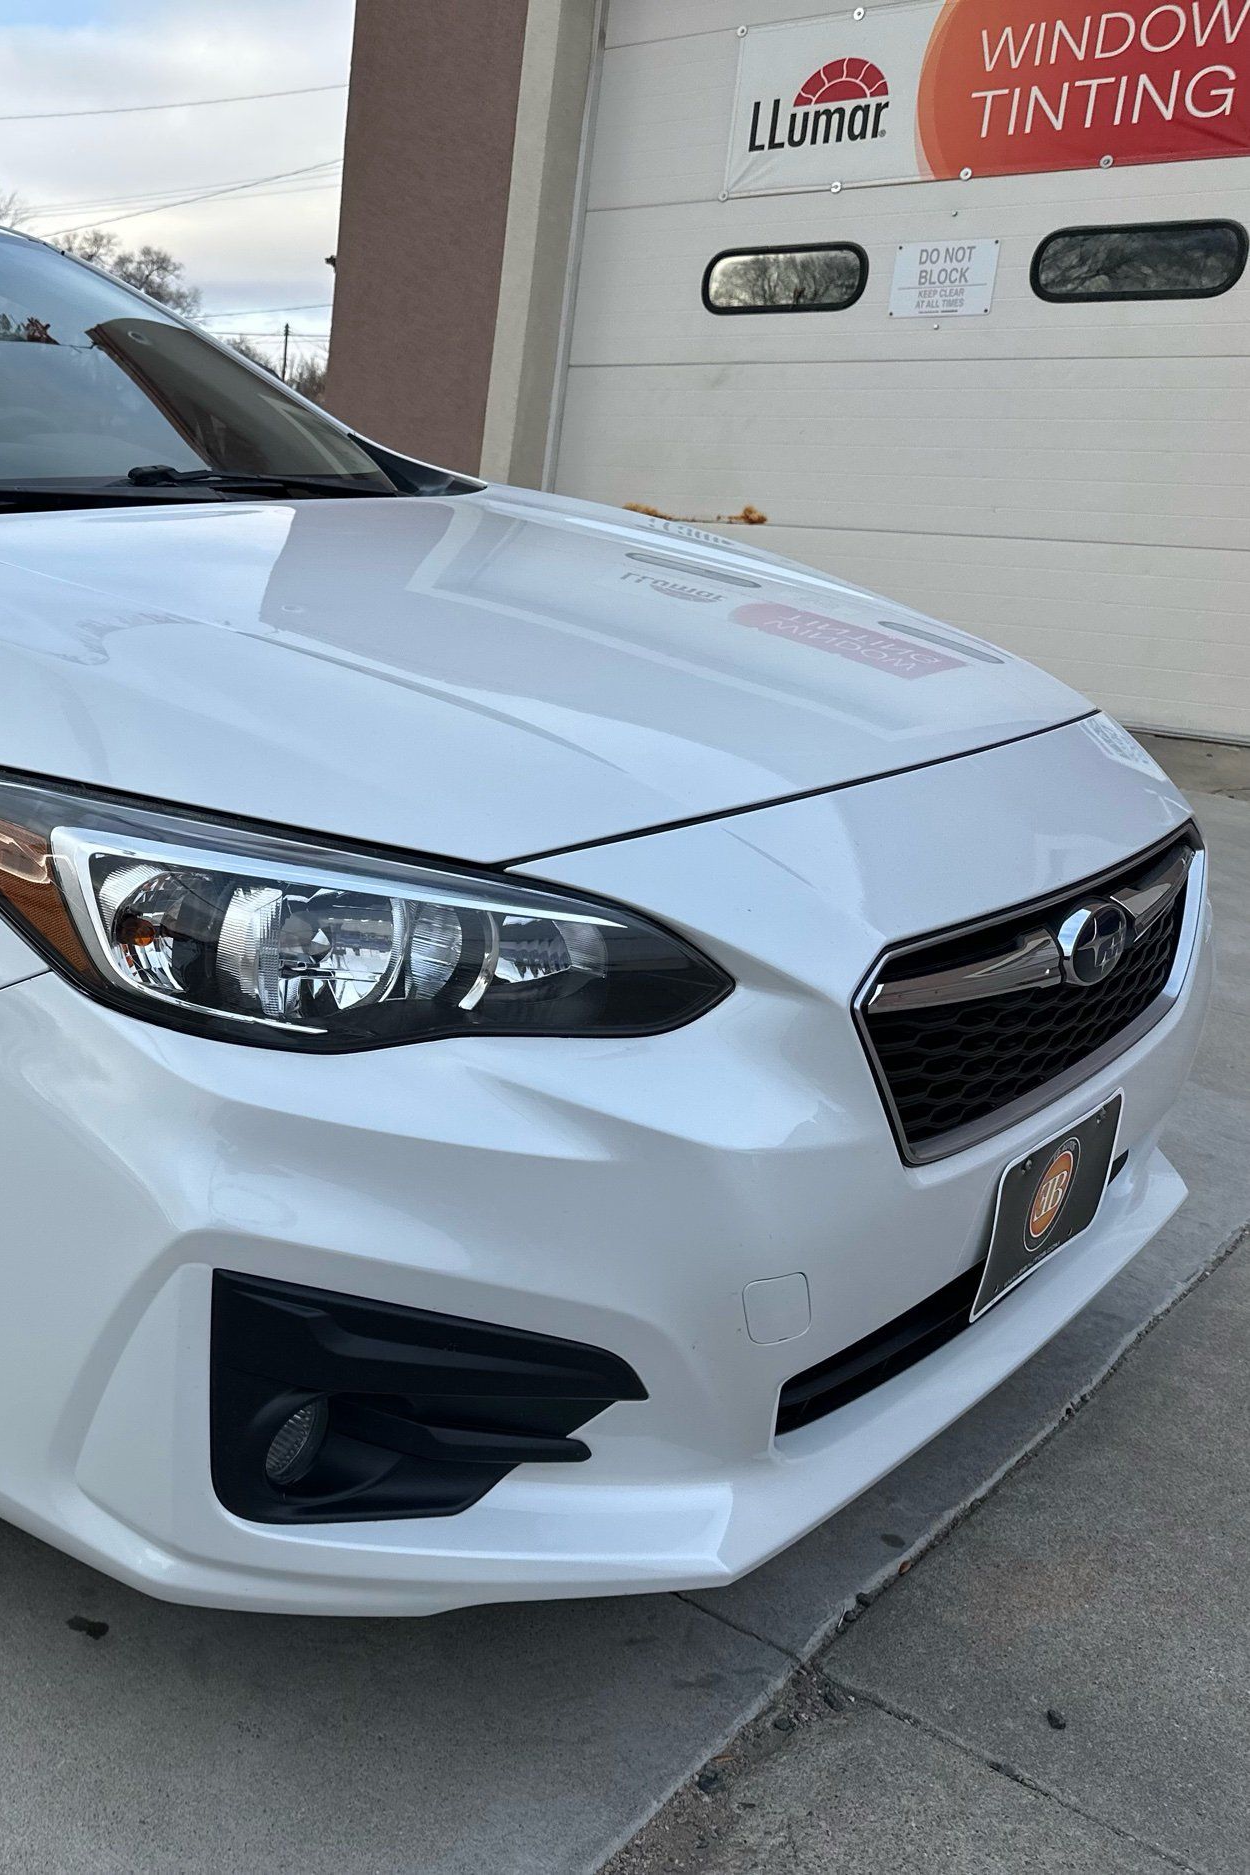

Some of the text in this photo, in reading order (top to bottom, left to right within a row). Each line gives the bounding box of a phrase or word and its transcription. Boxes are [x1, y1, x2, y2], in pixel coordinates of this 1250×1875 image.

[981, 0, 1250, 72] WINDOW
[971, 64, 1238, 138] TINTING
[748, 98, 889, 152] LLumar
[919, 246, 976, 265] DO NOT
[918, 267, 970, 286] BLOCK
[918, 288, 965, 298] KEEP CLEAR
[915, 298, 965, 309] AT ALL TIMES
